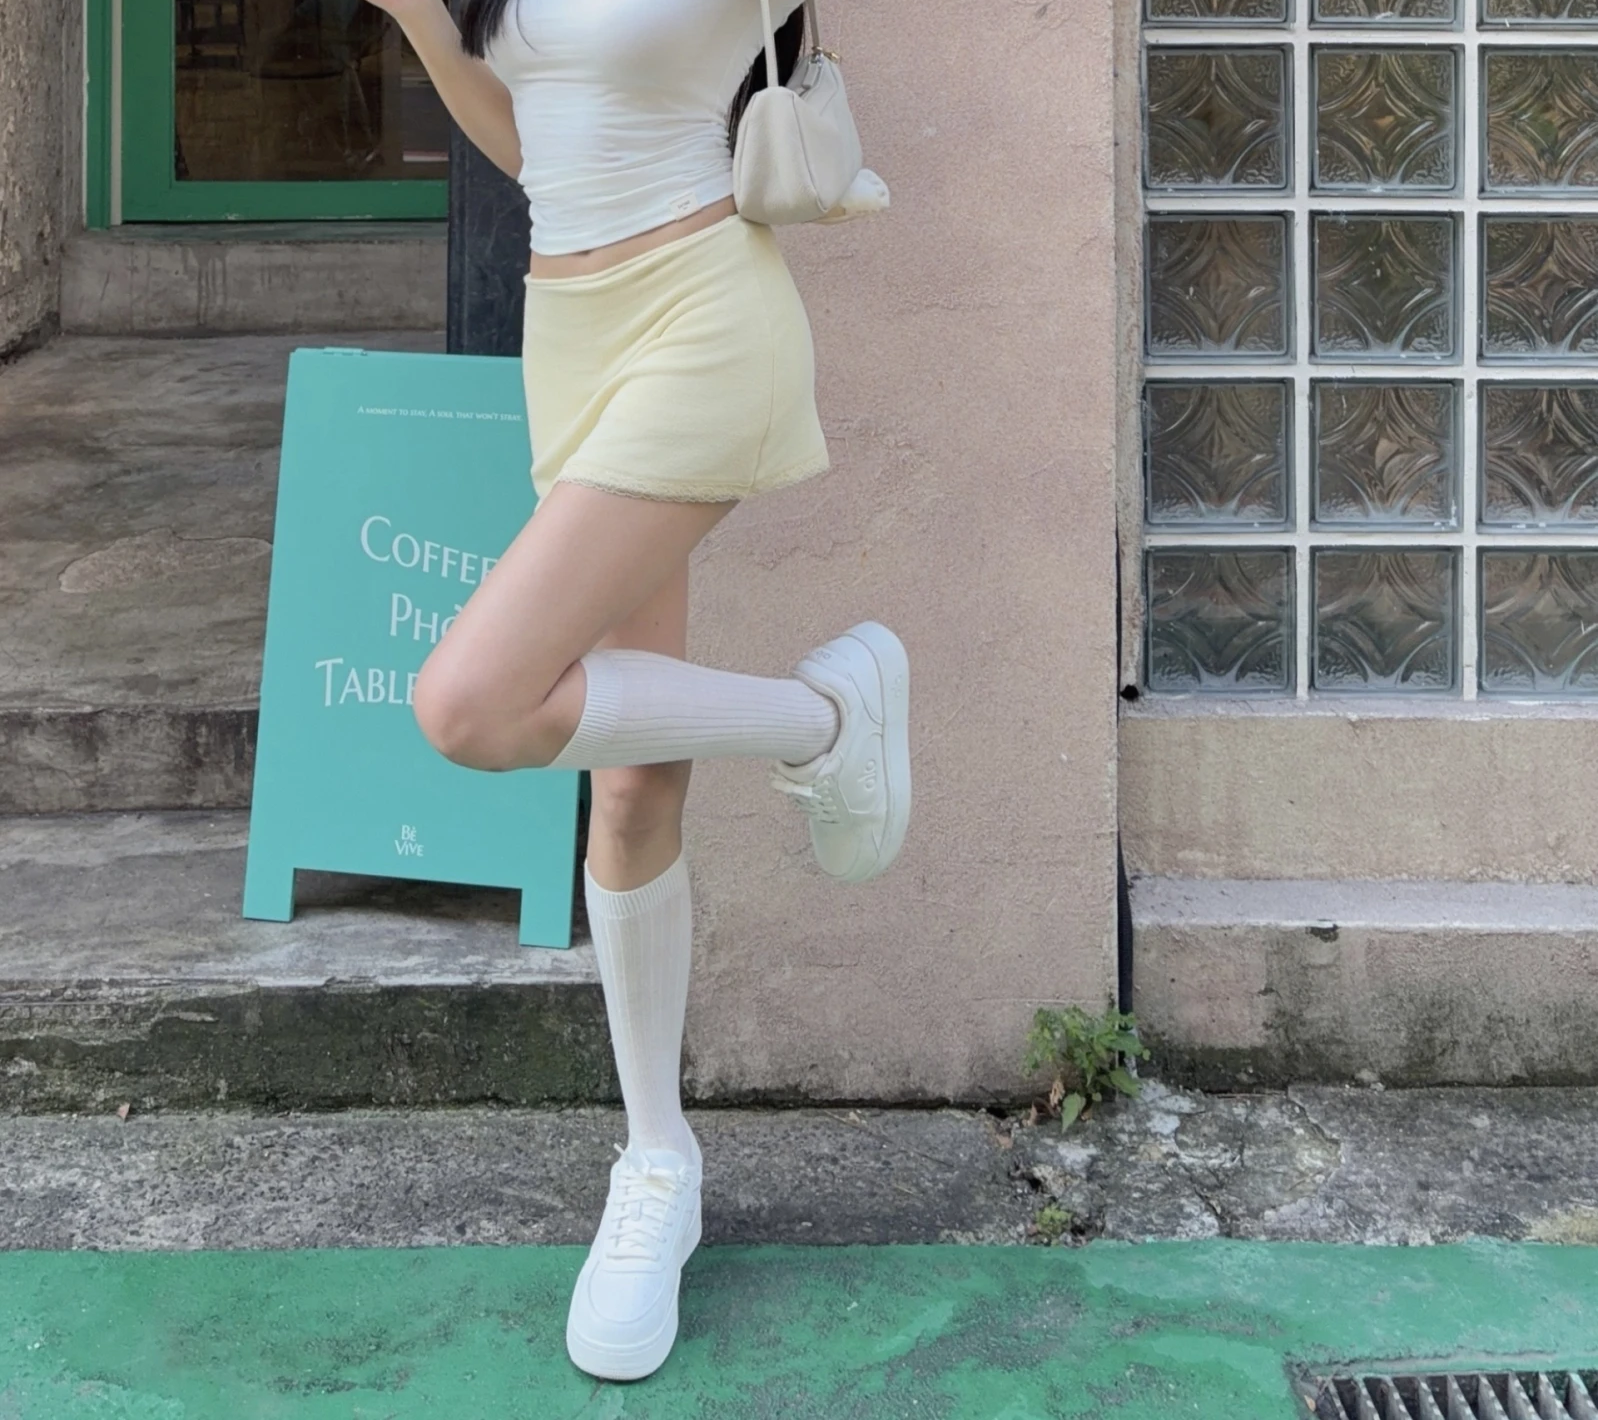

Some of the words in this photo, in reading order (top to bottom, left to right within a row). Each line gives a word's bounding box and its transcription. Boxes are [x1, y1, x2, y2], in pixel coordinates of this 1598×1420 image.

[356, 405, 365, 415] A
[398, 408, 409, 417] TO
[394, 839, 425, 857] VIVE
